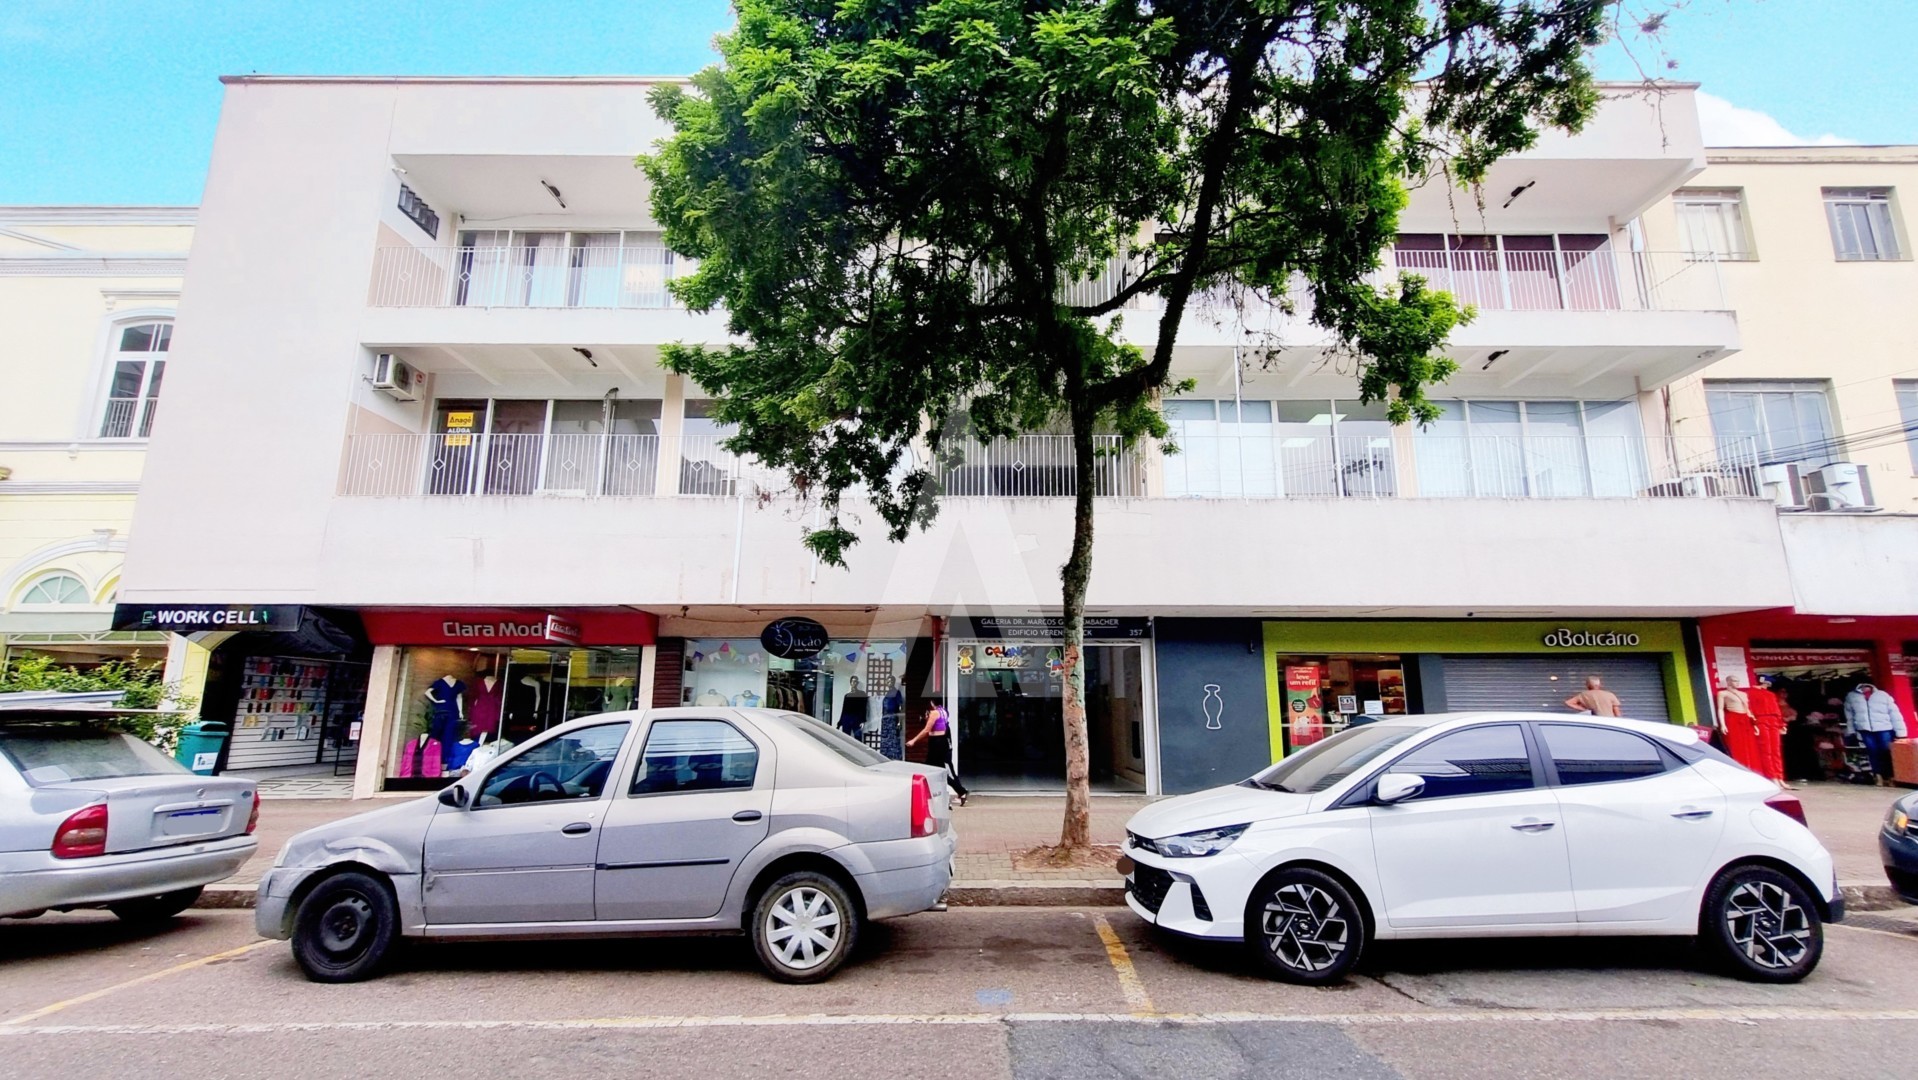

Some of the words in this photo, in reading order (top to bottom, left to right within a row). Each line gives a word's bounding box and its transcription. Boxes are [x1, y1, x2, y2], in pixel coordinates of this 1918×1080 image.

[157, 610, 210, 624] WORK
[212, 610, 260, 624] CELL
[442, 622, 495, 637] Clara
